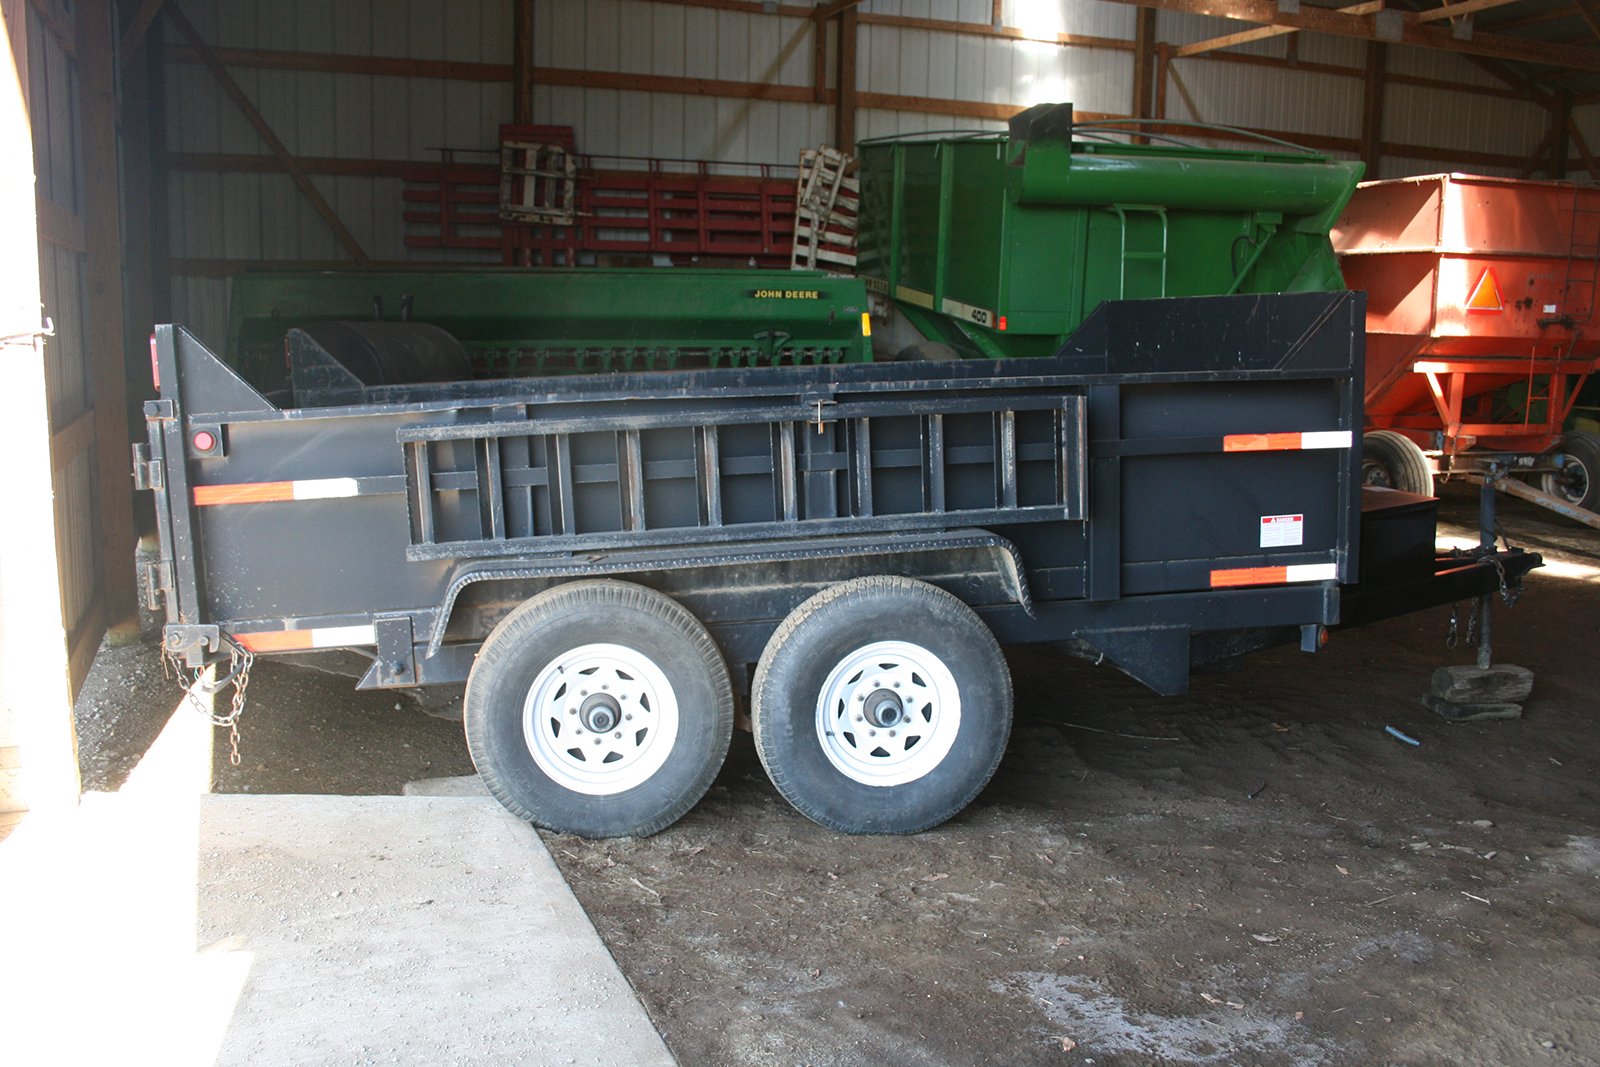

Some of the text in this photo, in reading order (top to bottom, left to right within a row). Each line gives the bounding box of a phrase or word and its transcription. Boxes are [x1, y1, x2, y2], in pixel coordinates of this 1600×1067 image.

[754, 289, 818, 299] JOHN DEERE
[971, 309, 987, 323] 400
